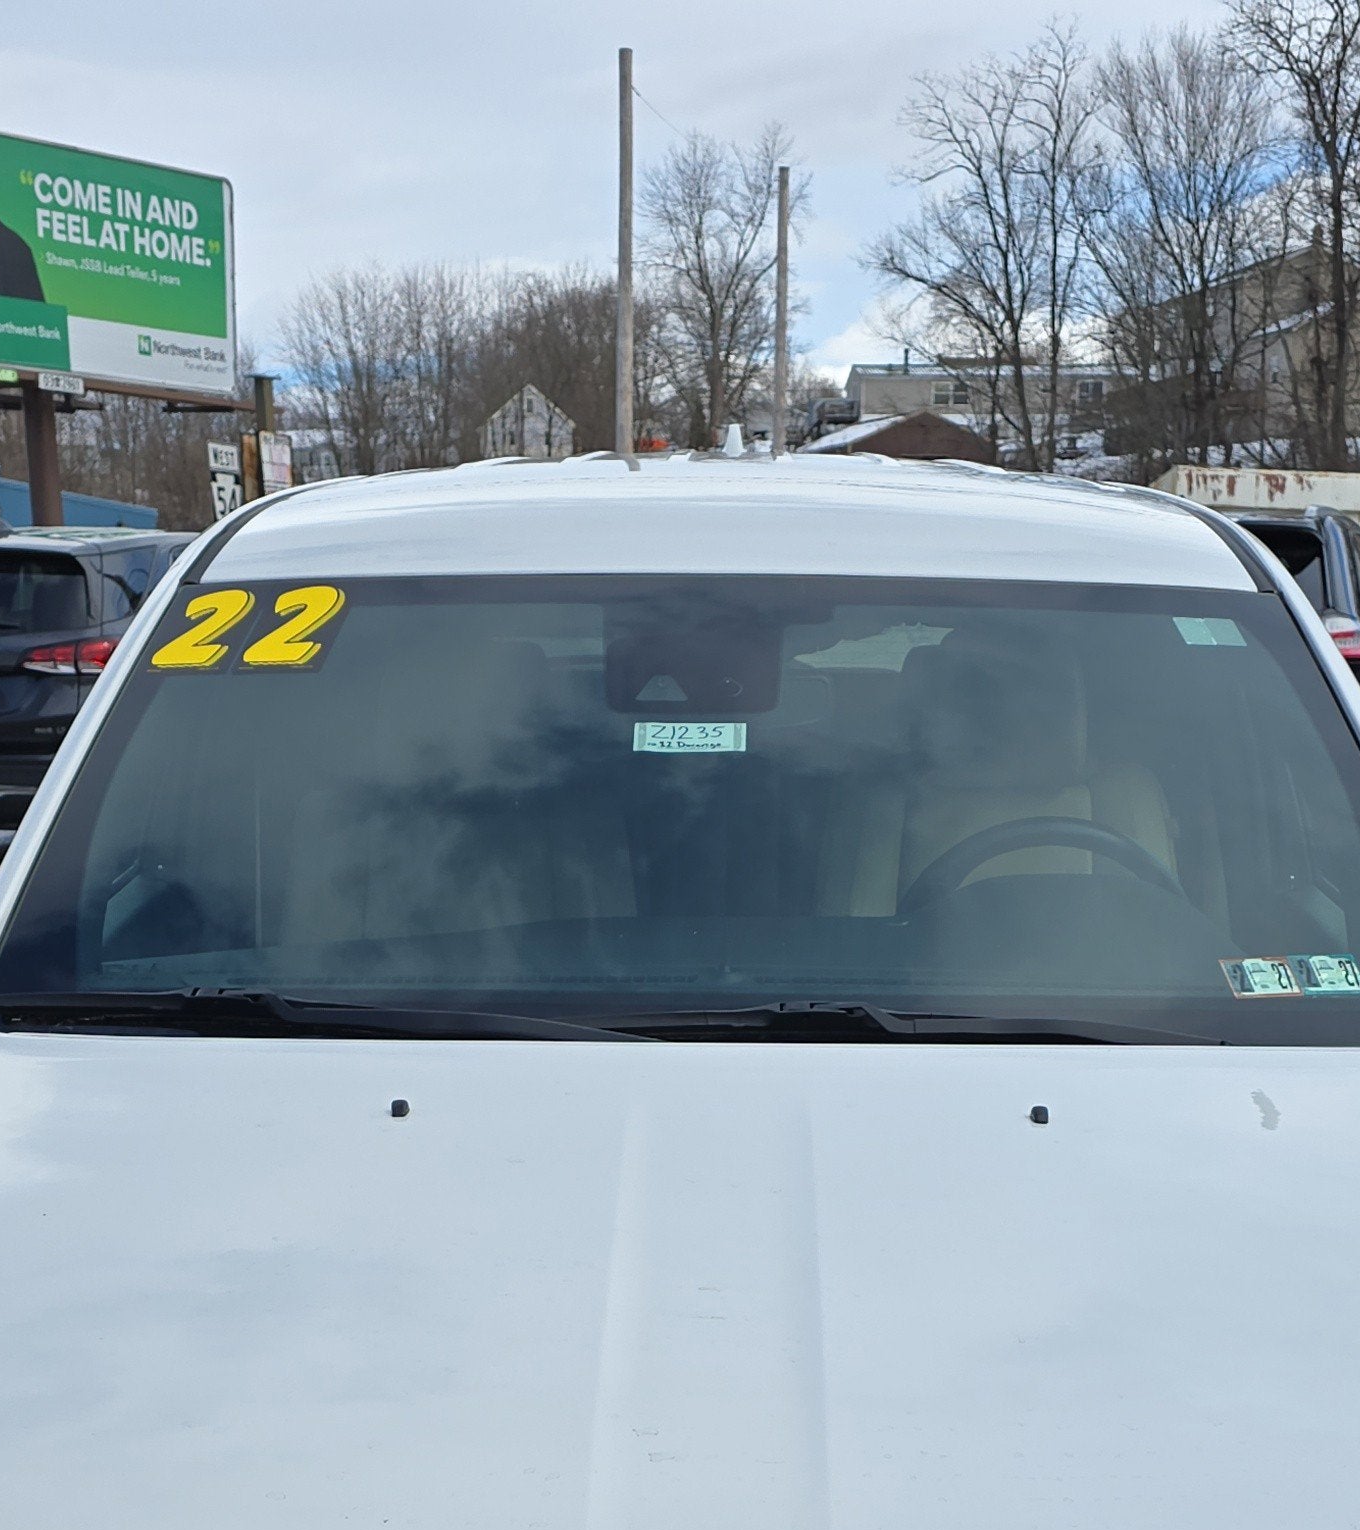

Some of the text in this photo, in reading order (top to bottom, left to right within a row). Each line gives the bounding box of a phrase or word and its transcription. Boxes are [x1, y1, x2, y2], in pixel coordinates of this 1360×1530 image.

[35, 208, 97, 247] FEEL
[98, 220, 130, 252] AT
[115, 187, 143, 222] IN
[146, 195, 199, 231] AND
[151, 586, 345, 668] 22
